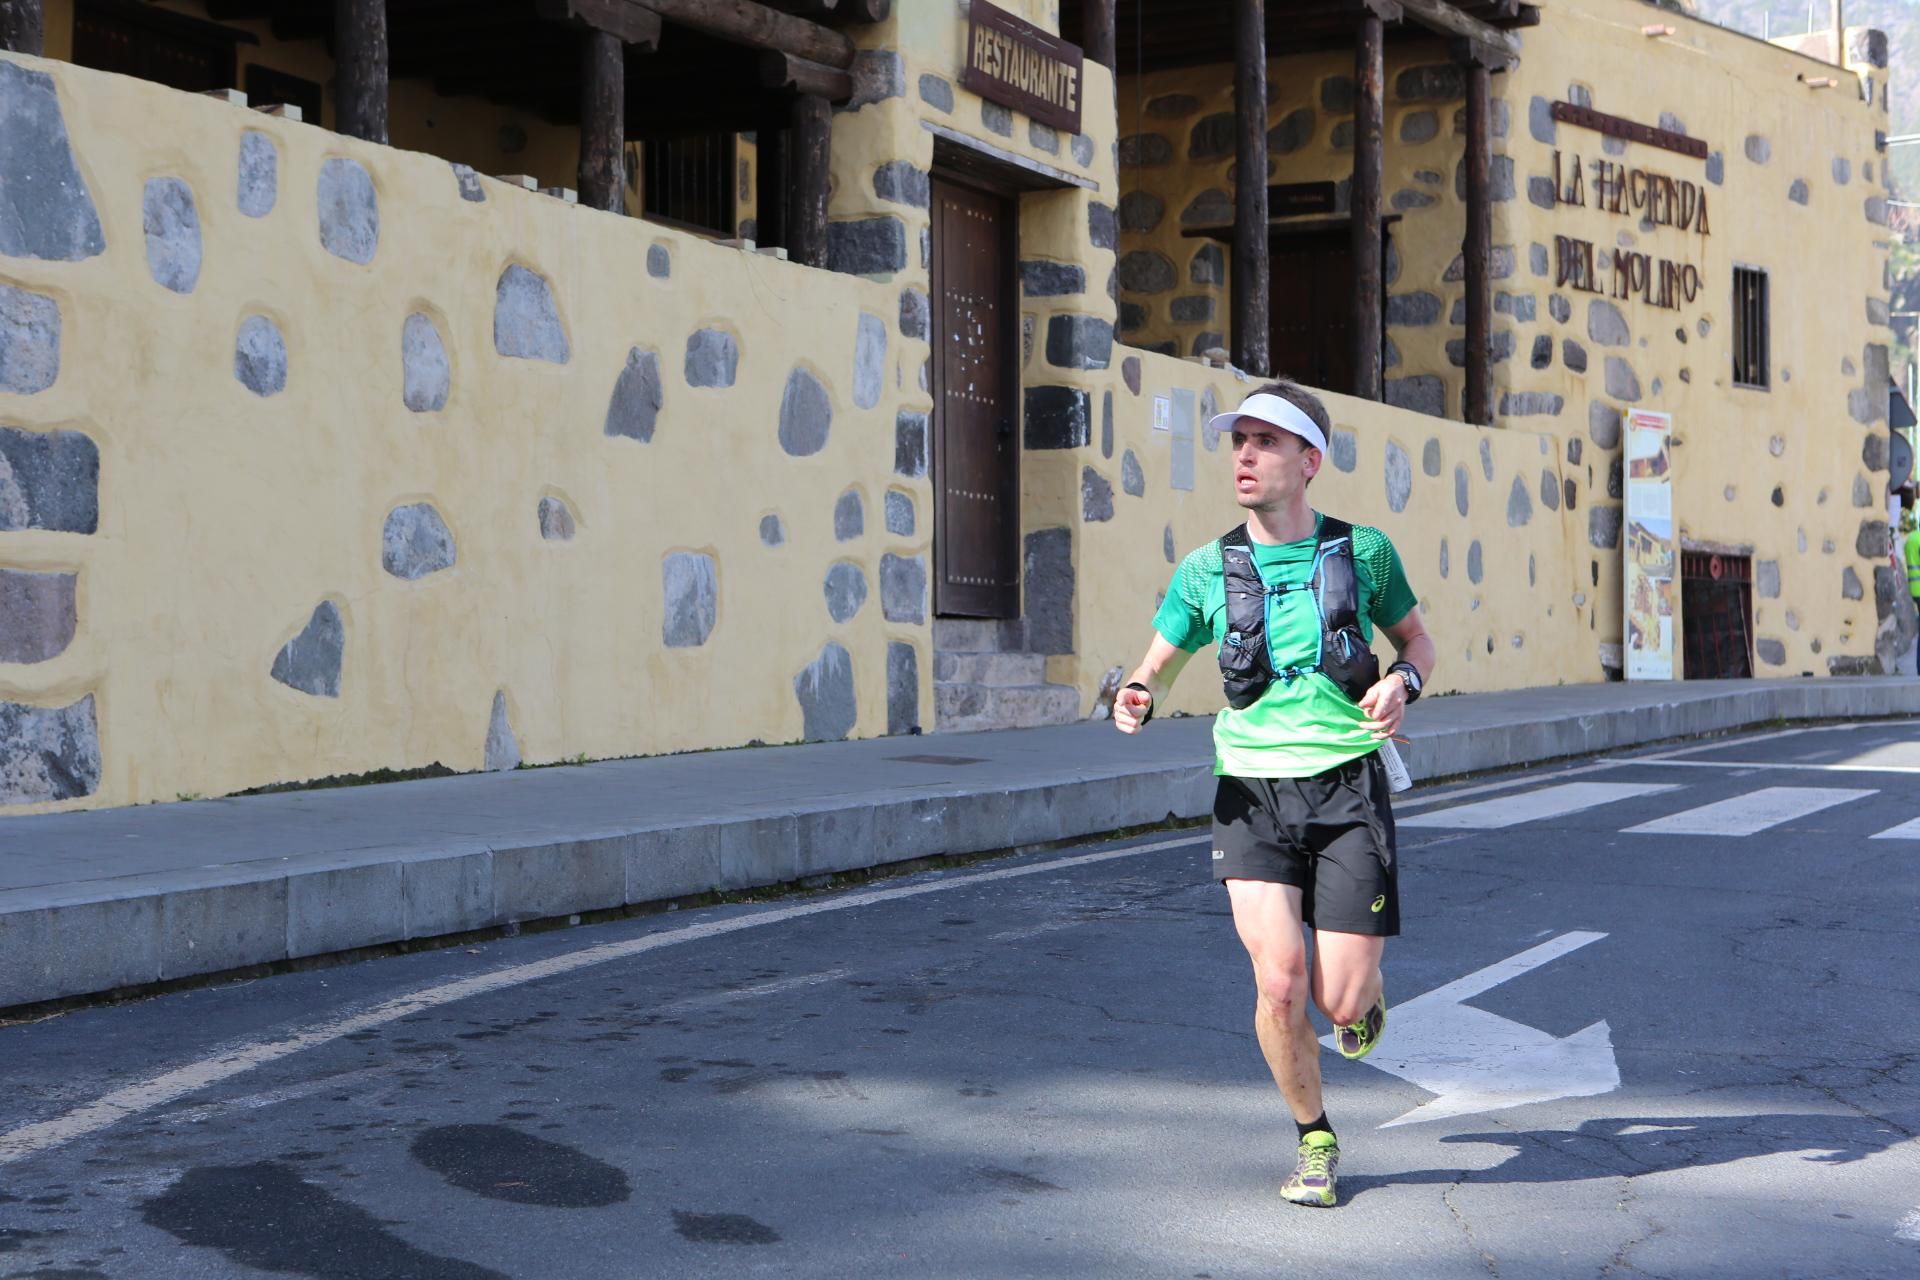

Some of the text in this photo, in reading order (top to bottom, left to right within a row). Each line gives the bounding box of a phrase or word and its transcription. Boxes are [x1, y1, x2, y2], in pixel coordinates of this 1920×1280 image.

[973, 23, 1077, 112] RESTAURANTE
[1554, 150, 1711, 236] LA HACIENDA
[1554, 235, 1698, 312] DEL MOLINO
